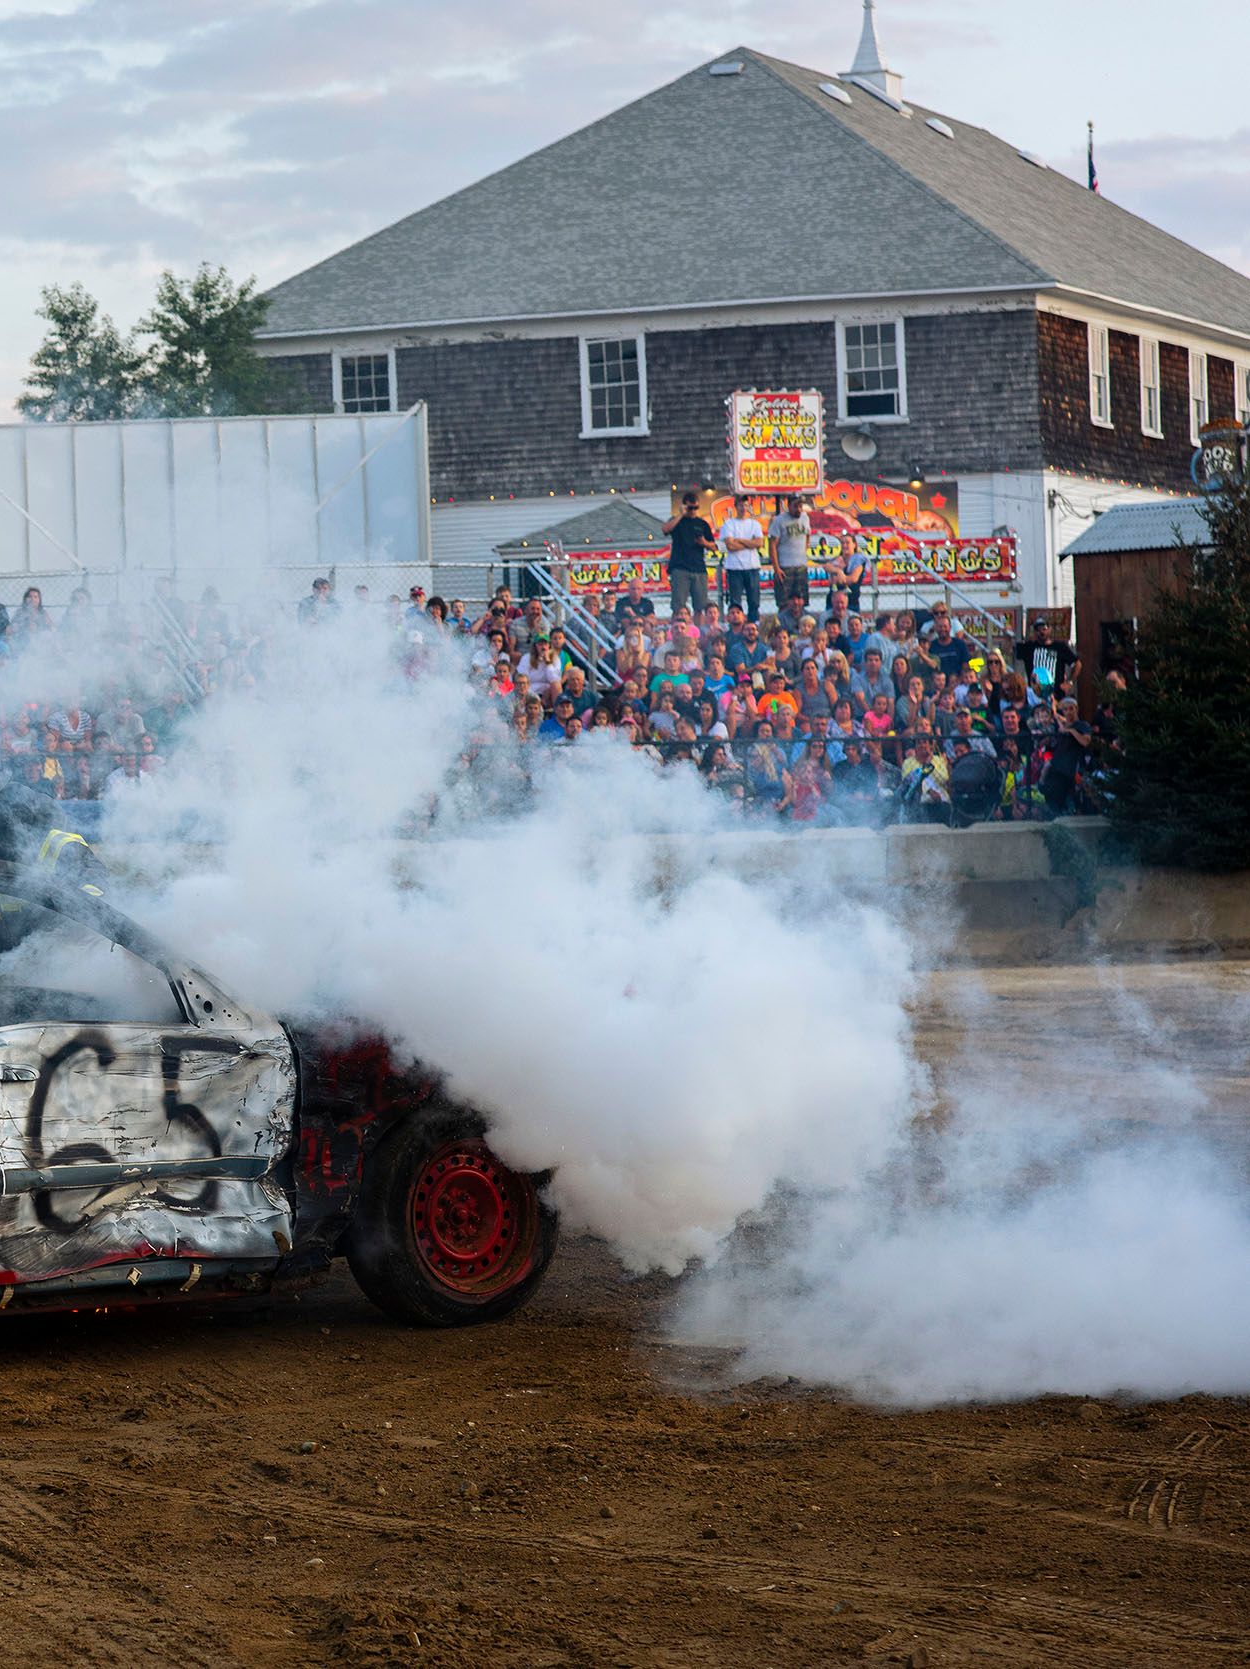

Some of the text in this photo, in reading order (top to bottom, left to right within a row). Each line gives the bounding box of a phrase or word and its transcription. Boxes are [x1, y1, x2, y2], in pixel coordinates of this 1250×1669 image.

[739, 407, 817, 426] FRIED
[739, 425, 816, 450] CLAMS
[741, 462, 816, 485] CHICKEN
[570, 561, 671, 585] GIAN
[892, 546, 1002, 574] RINGS
